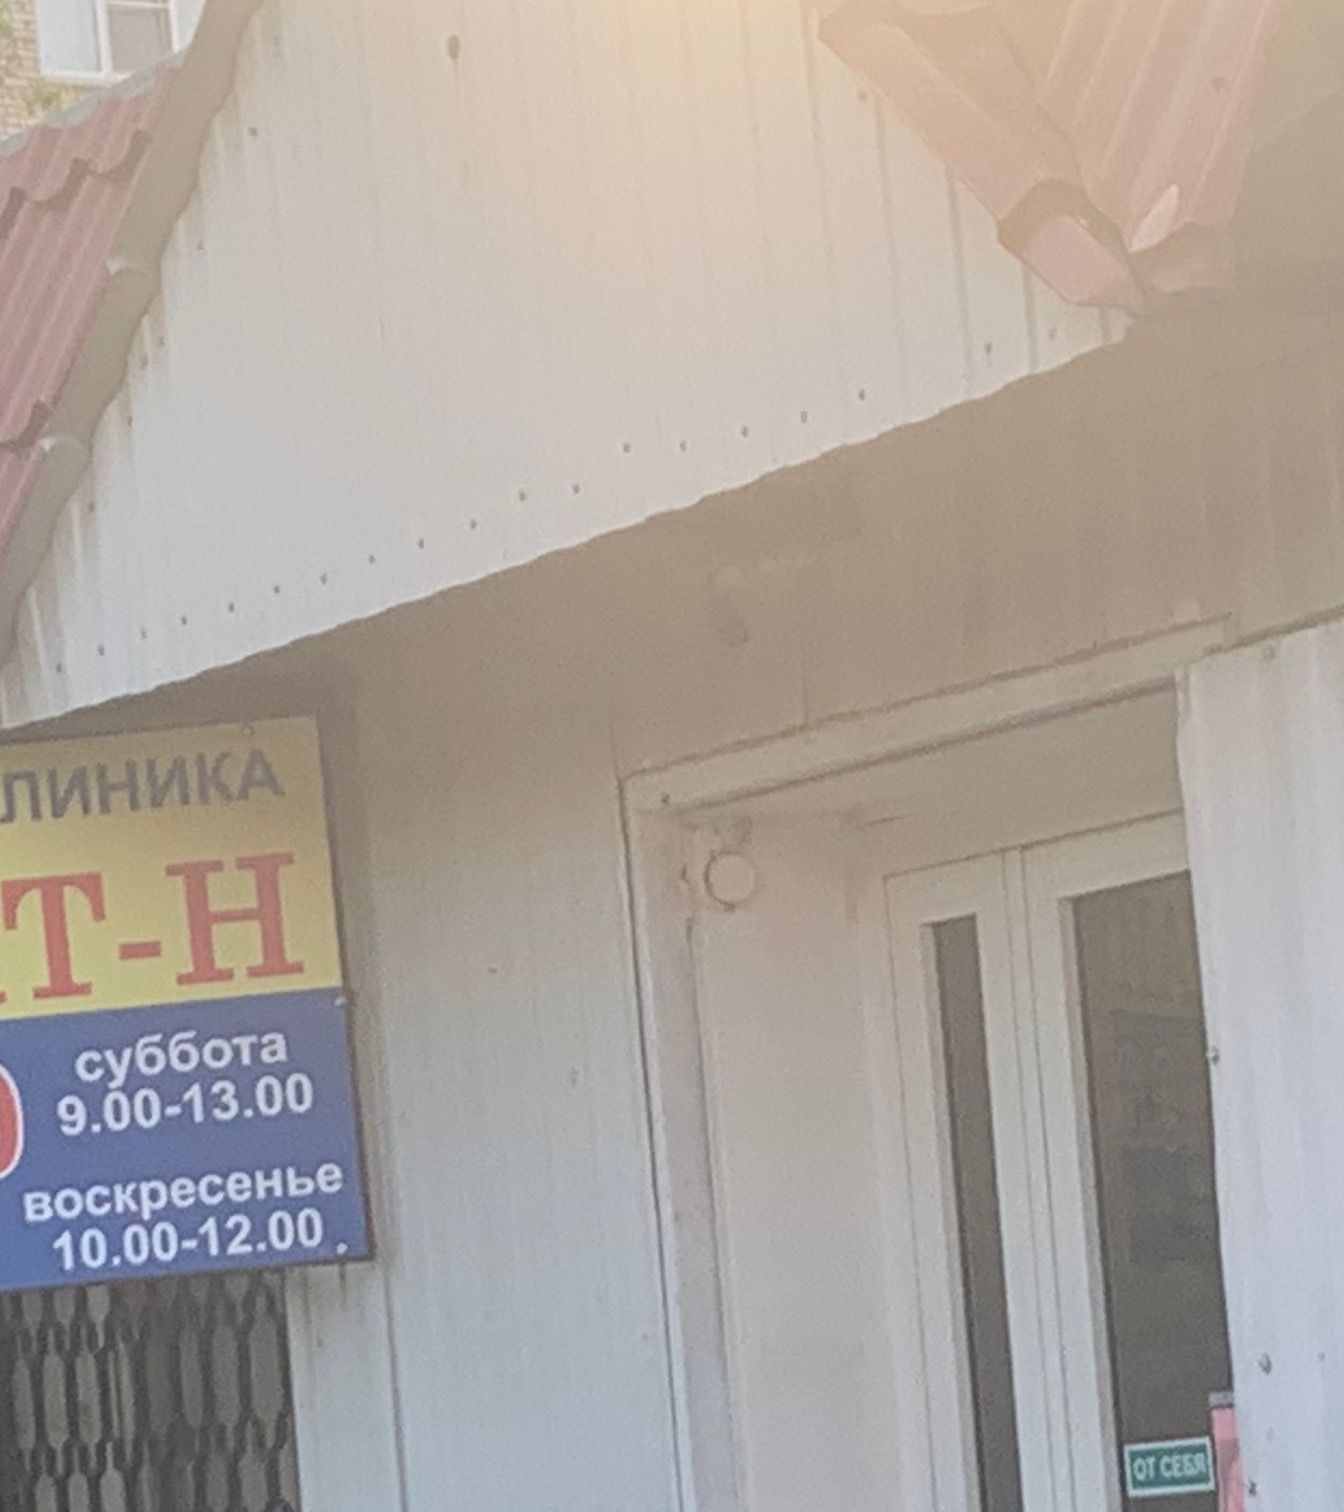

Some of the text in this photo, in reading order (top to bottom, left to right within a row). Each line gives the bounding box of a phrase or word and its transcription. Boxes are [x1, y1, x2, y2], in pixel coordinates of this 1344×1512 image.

[75, 1030, 288, 1089] суббота
[57, 1073, 314, 1136] 9.00-13.00
[23, 1162, 344, 1223] воскресенье
[53, 1208, 324, 1271] 10.00-12.00
[1133, 1452, 1206, 1480] ОТ СЕБЯ
